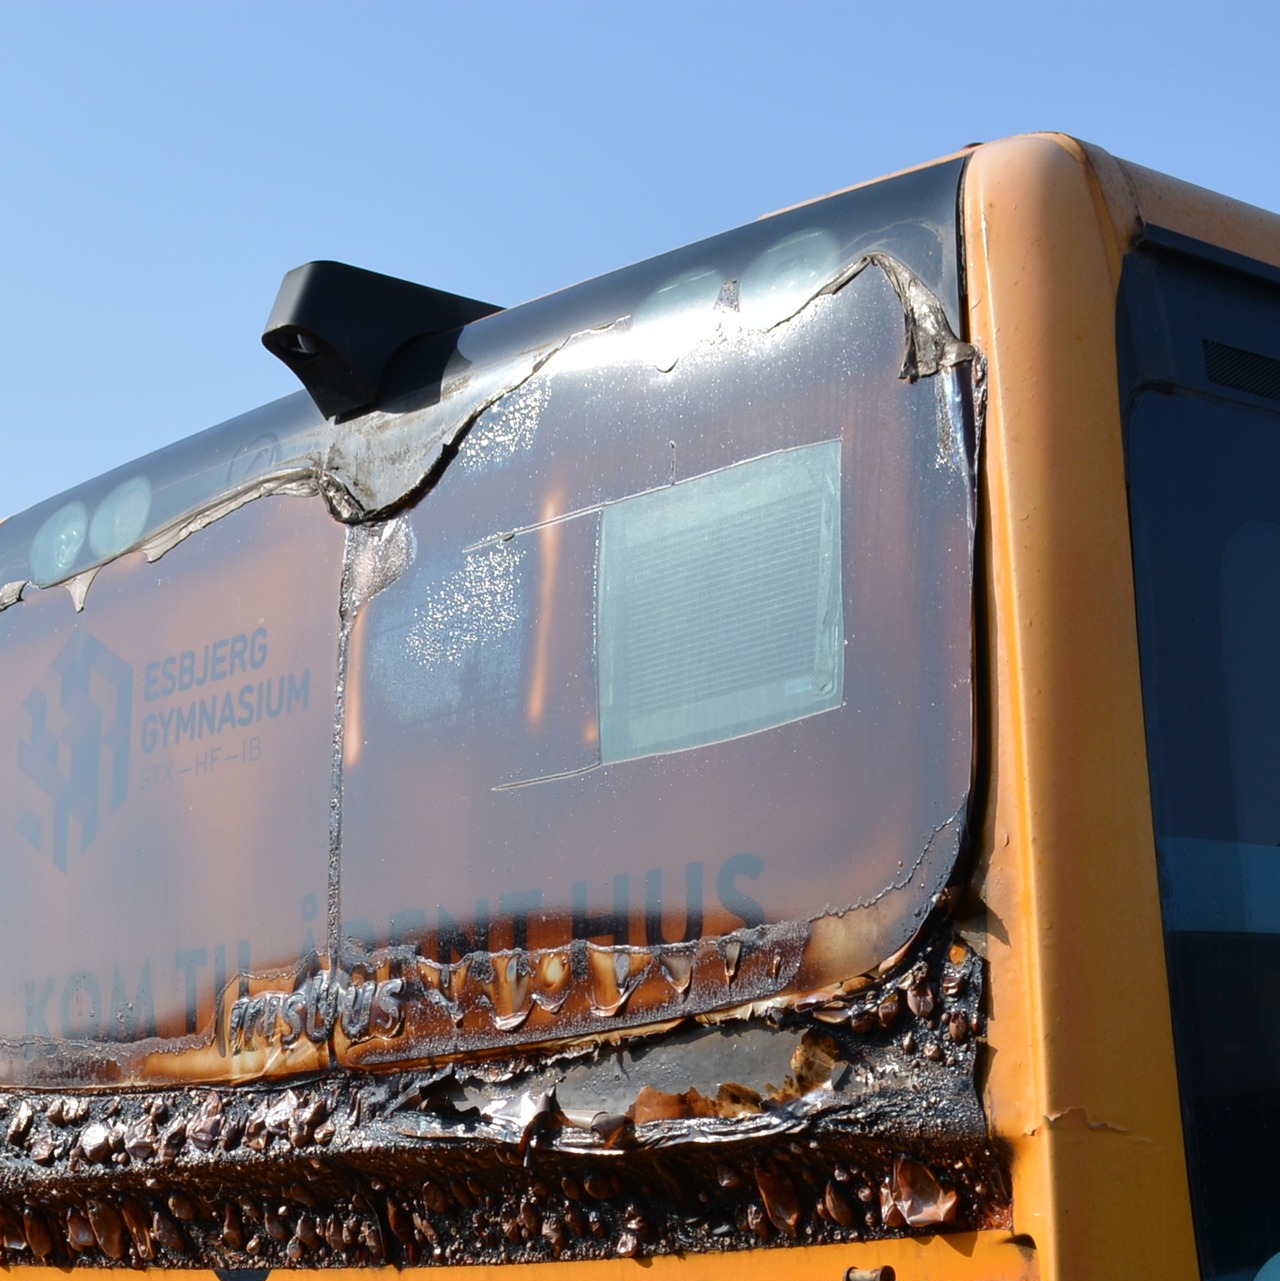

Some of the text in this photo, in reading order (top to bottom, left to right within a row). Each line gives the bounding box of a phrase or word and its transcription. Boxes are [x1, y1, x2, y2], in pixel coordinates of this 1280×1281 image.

[144, 627, 268, 702] ESBJERG
[141, 667, 311, 753] GYMNASIUM
[24, 957, 157, 1058] KOM
[570, 853, 766, 980] HUS
